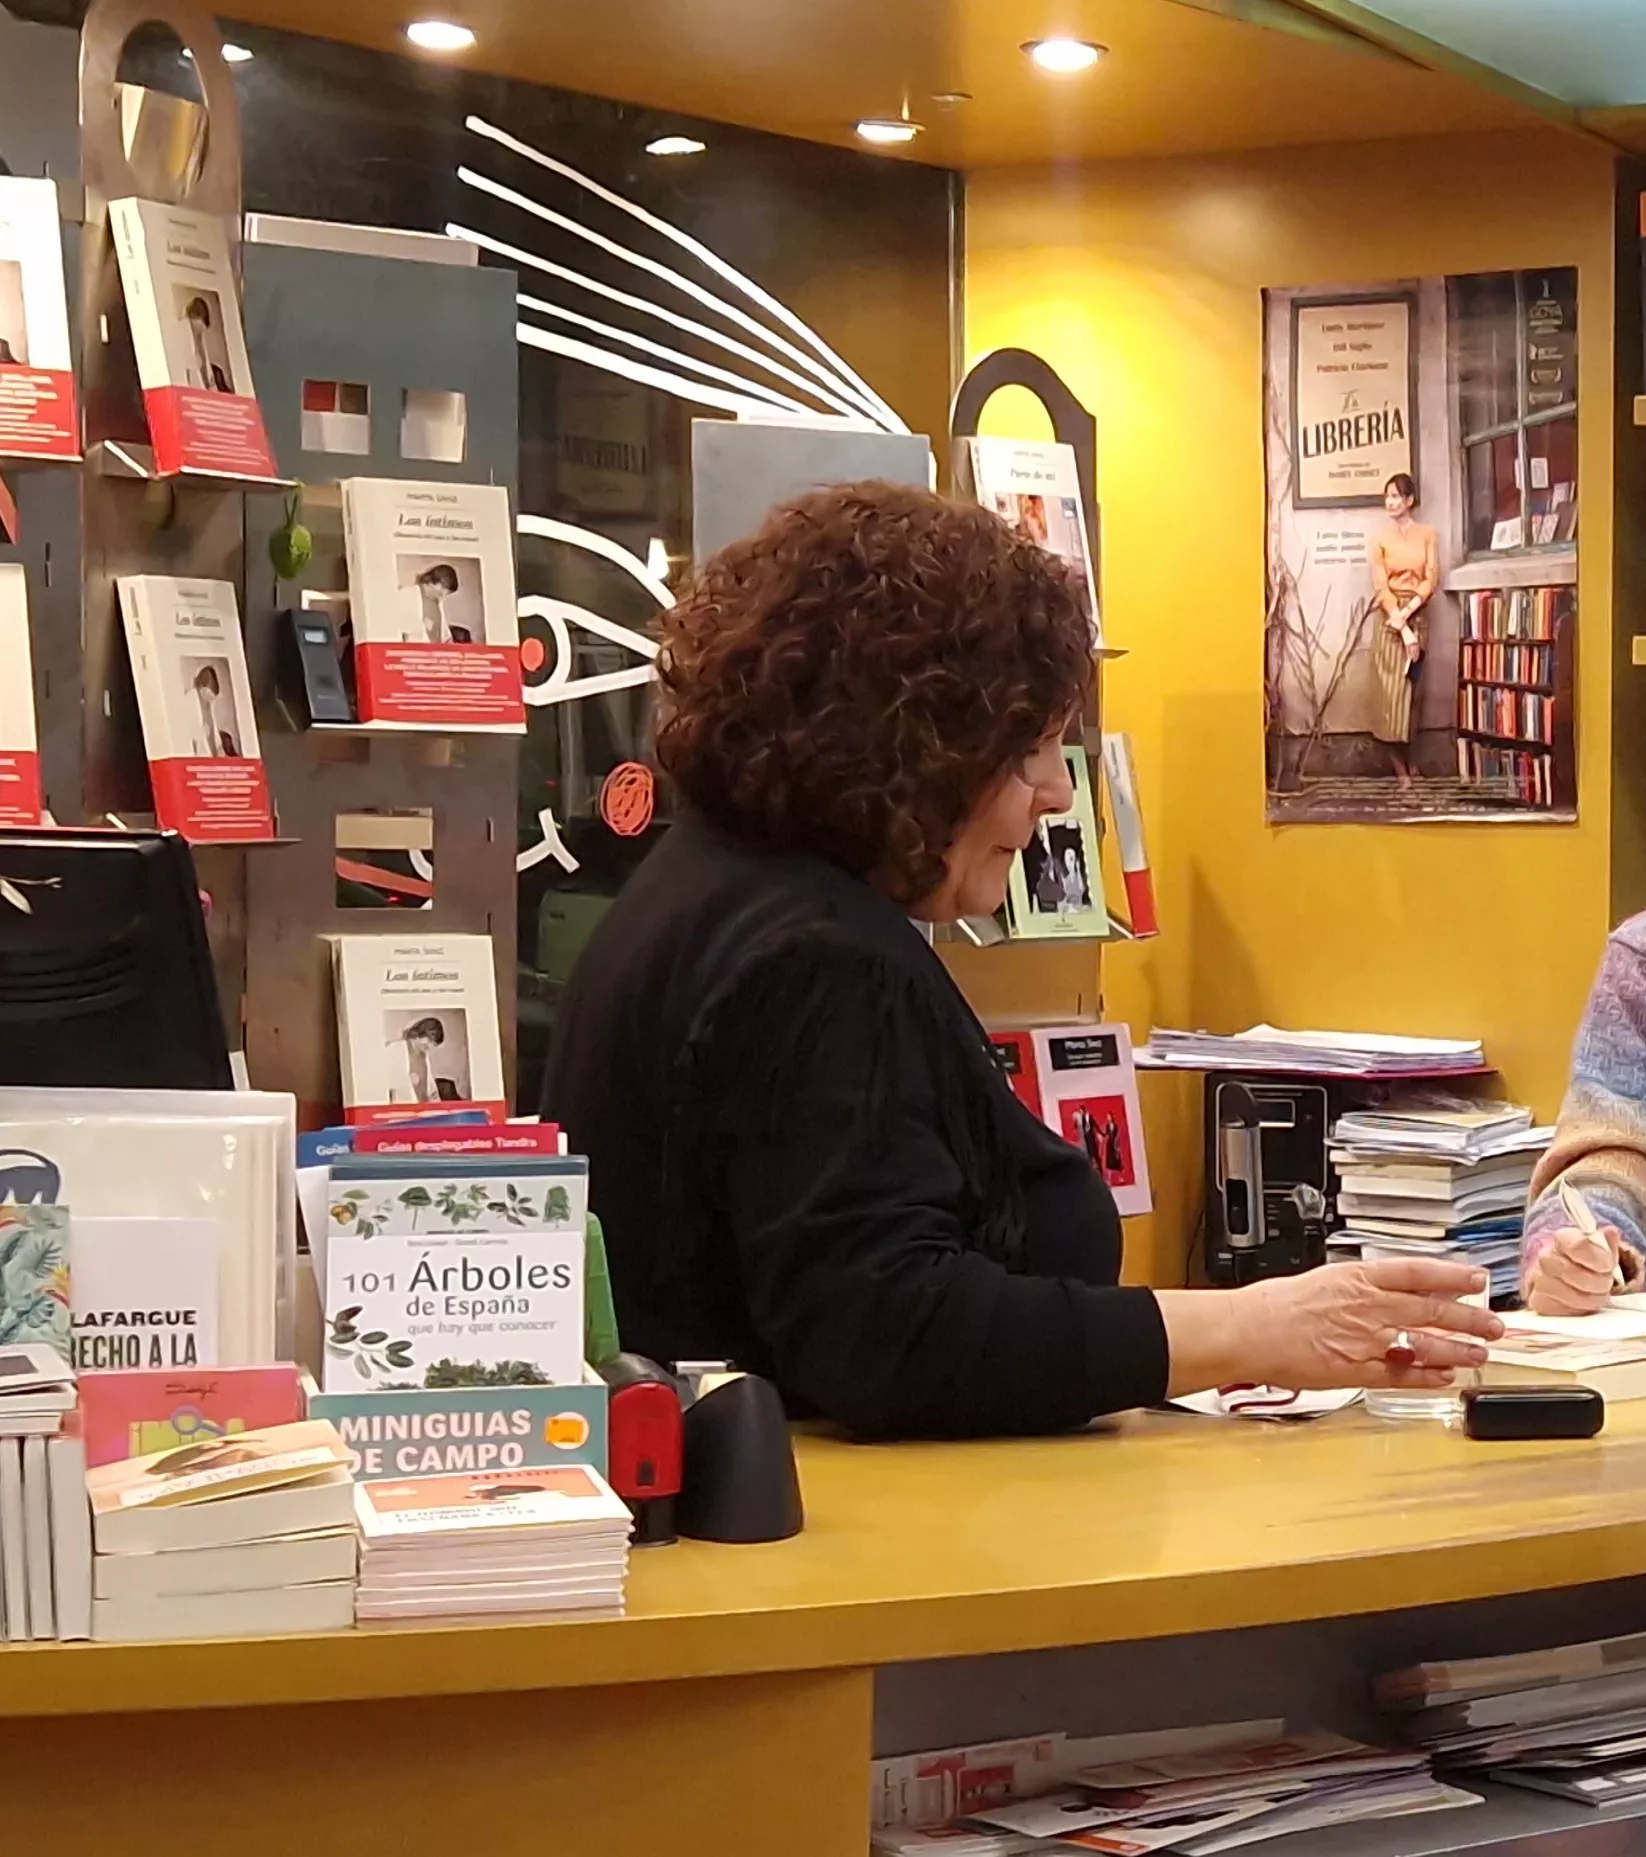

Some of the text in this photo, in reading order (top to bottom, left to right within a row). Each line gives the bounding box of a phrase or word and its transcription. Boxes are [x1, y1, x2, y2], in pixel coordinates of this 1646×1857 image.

[1302, 399, 1405, 459] LIBRERÍA
[385, 969, 409, 982] Los
[343, 1251, 572, 1293] 101 Árboles
[71, 1310, 197, 1328] LAFARGUE
[406, 1295, 530, 1320] de España
[407, 1320, 557, 1337] que hay que conocer
[149, 1334, 163, 1368] A
[171, 1333, 197, 1367] LA
[338, 1410, 532, 1442] MINIGUIAS
[396, 1442, 524, 1473] CAMPO
